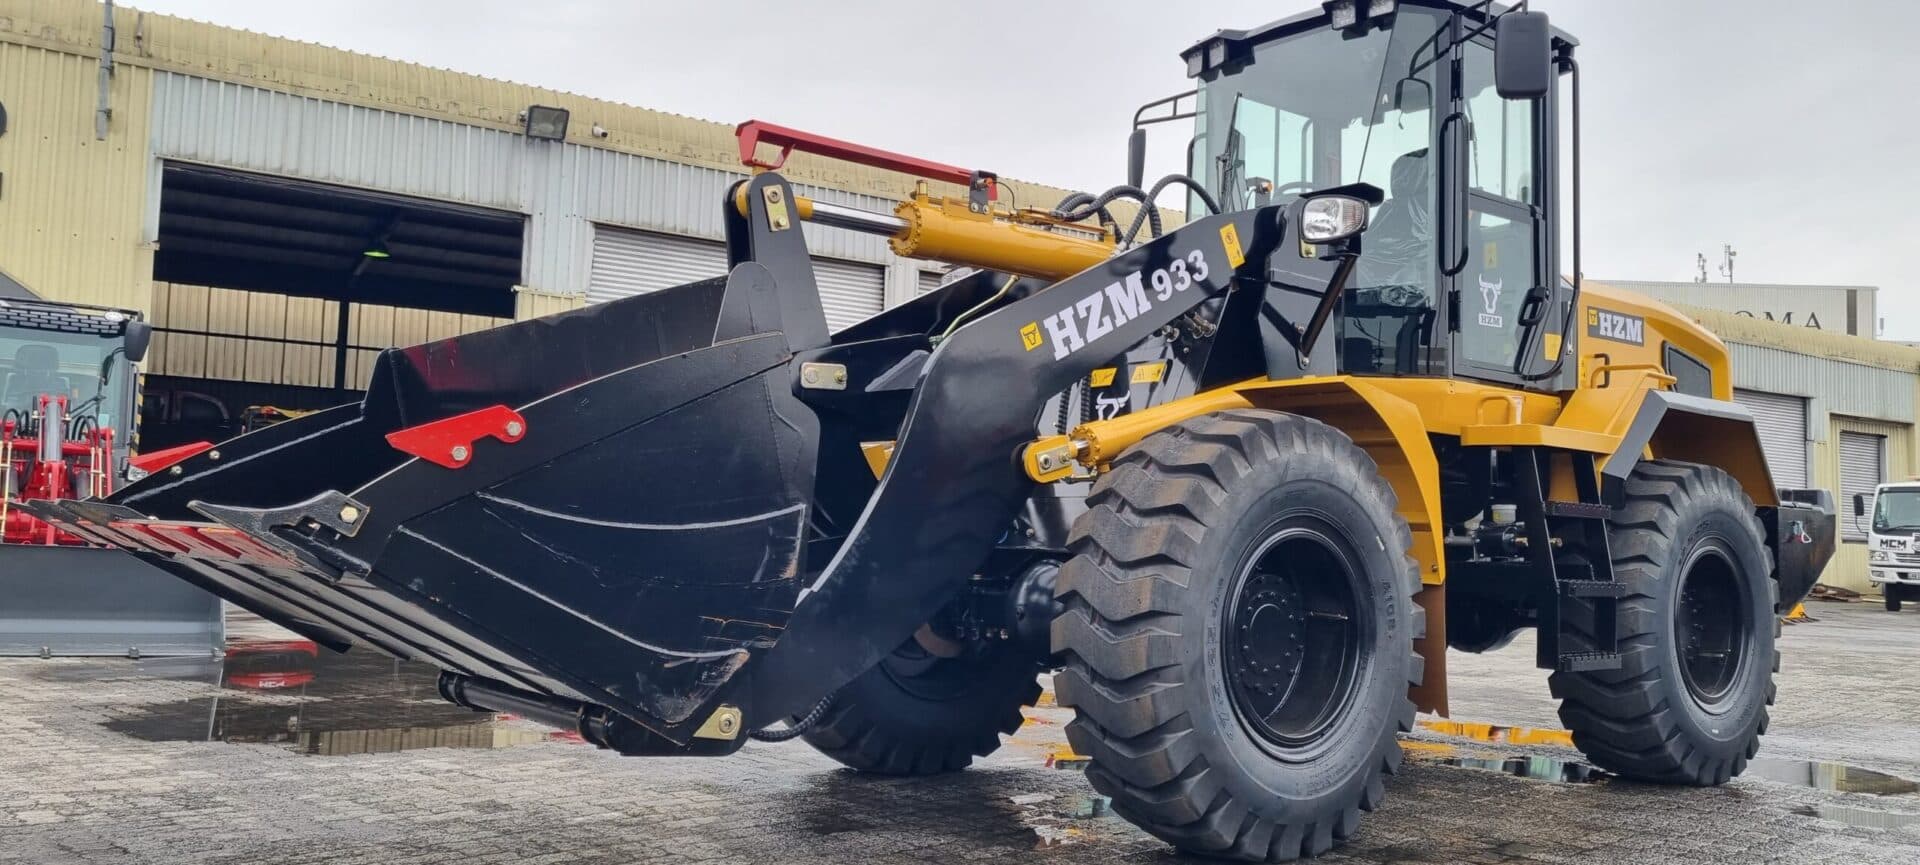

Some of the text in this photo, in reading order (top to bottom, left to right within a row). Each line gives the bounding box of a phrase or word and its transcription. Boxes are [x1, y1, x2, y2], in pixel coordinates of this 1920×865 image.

[1043, 249, 1209, 361] HZM 933
[1480, 314, 1502, 326] HZM
[1598, 312, 1644, 344] HZM
[1880, 538, 1907, 549] MCM
